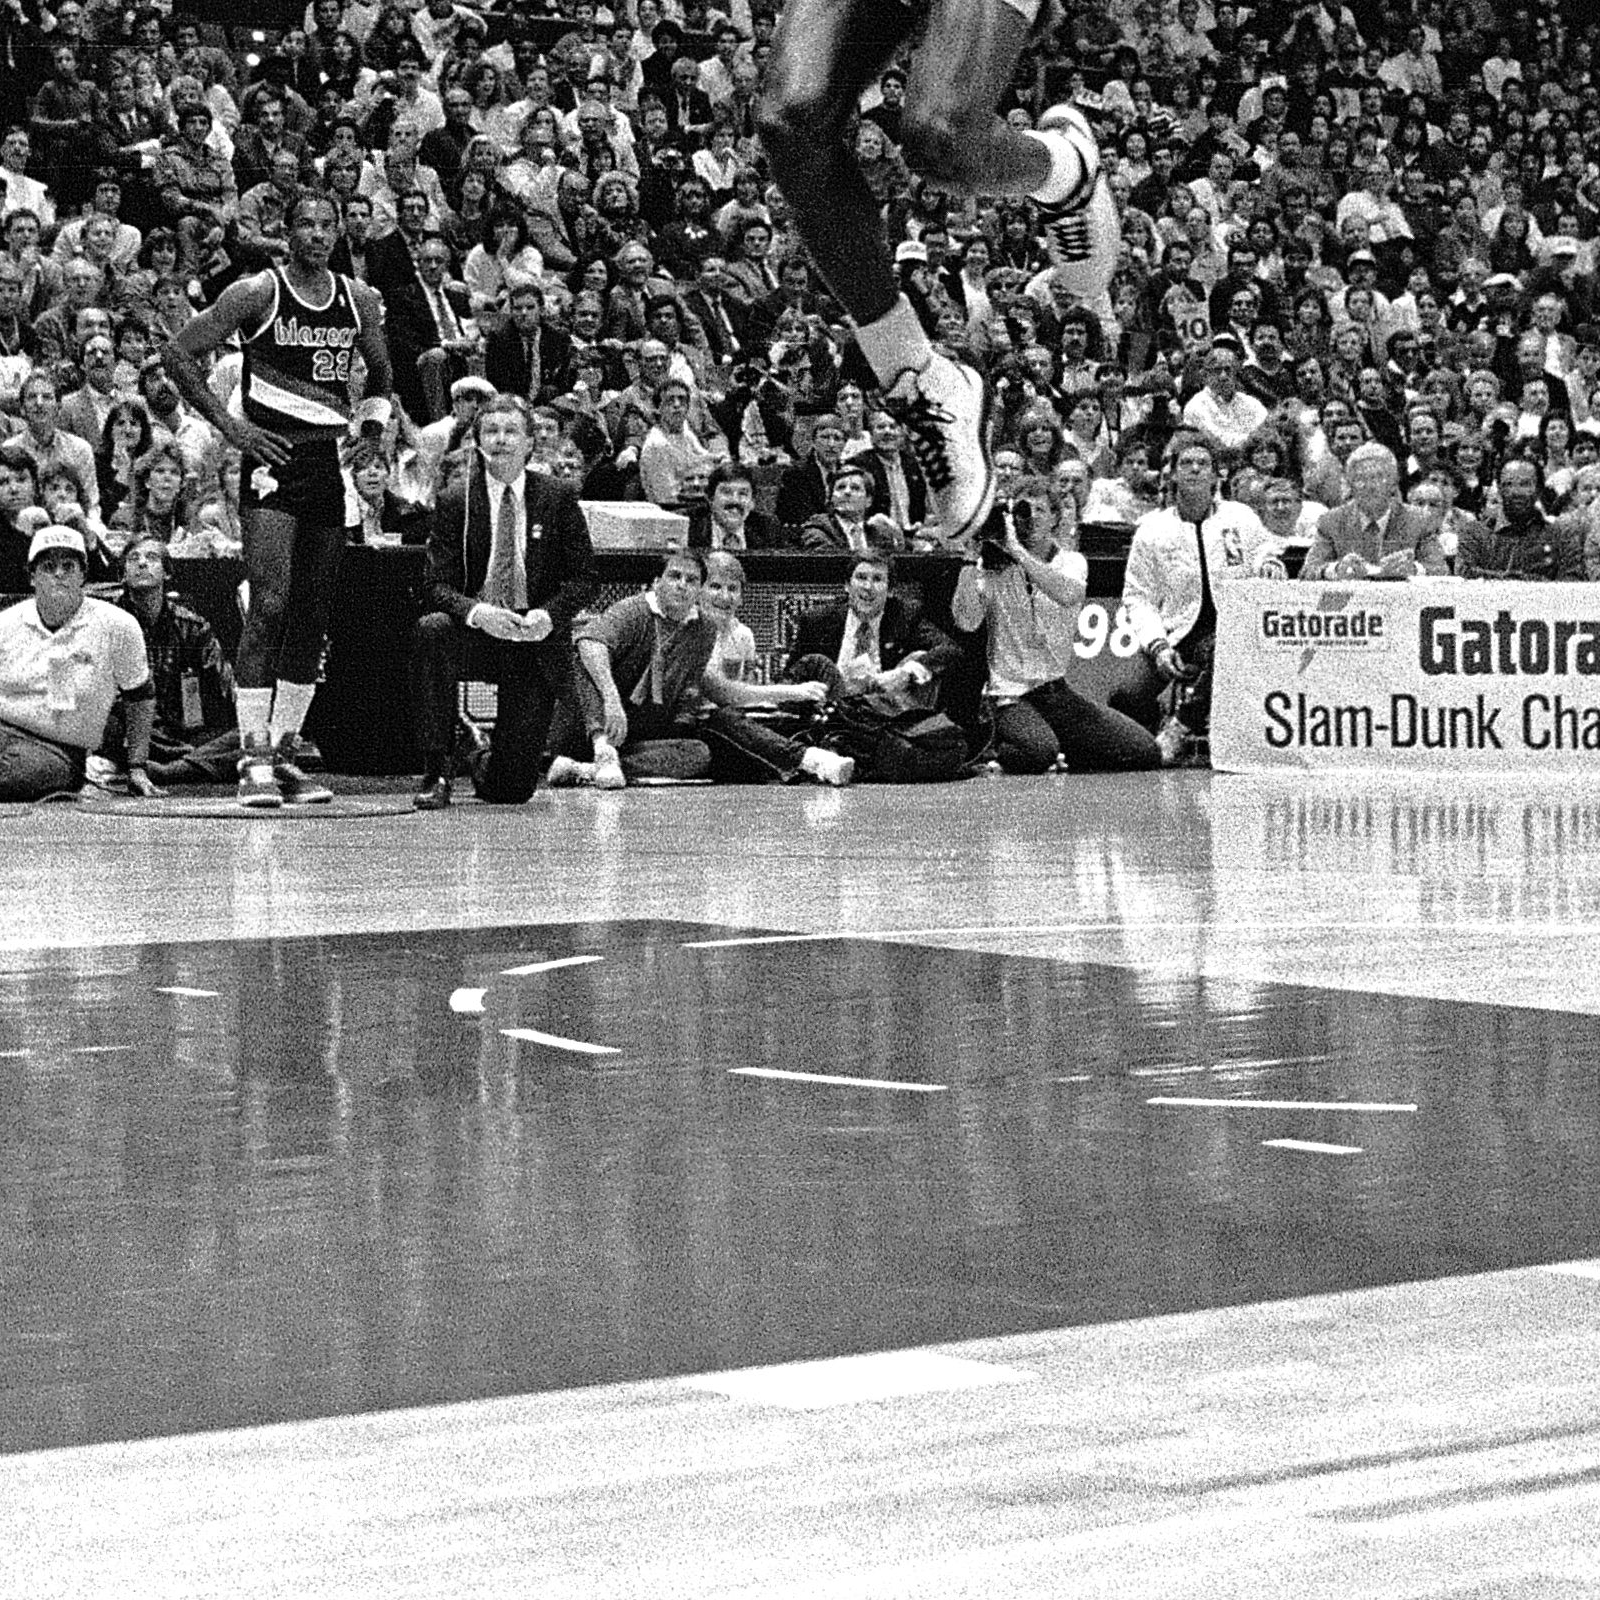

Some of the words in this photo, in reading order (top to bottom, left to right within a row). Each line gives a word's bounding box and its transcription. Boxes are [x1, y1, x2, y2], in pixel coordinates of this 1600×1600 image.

[1178, 317, 1208, 341] 10
[1072, 603, 1142, 660] 98
[1262, 609, 1384, 639] Gatorade
[1263, 690, 1502, 752] Slam-Dunk
